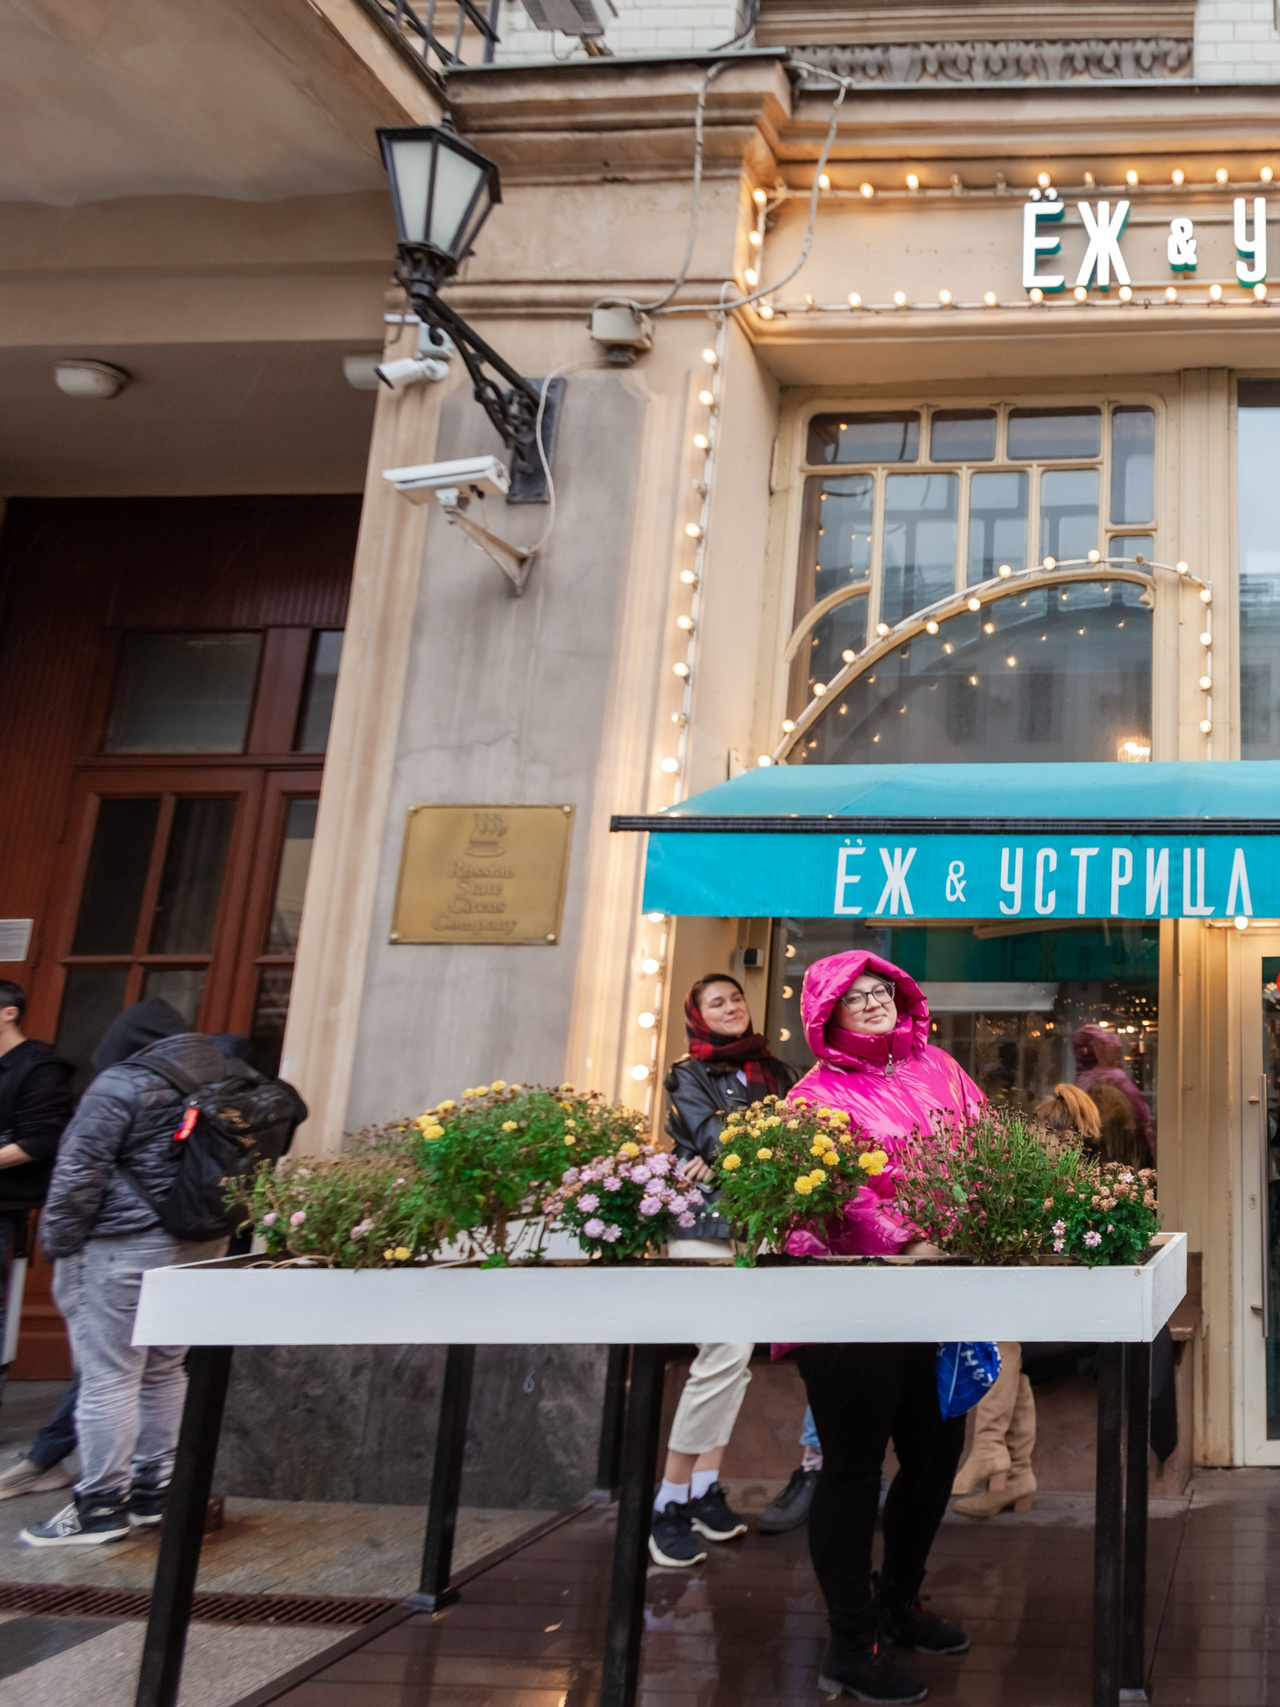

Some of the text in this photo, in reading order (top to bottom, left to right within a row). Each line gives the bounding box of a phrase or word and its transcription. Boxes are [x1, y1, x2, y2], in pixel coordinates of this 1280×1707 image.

[1022, 186, 1132, 291] ЁЖ
[1166, 217, 1198, 271] &
[833, 838, 1253, 915] ЁЖ & УСТРИЦА
